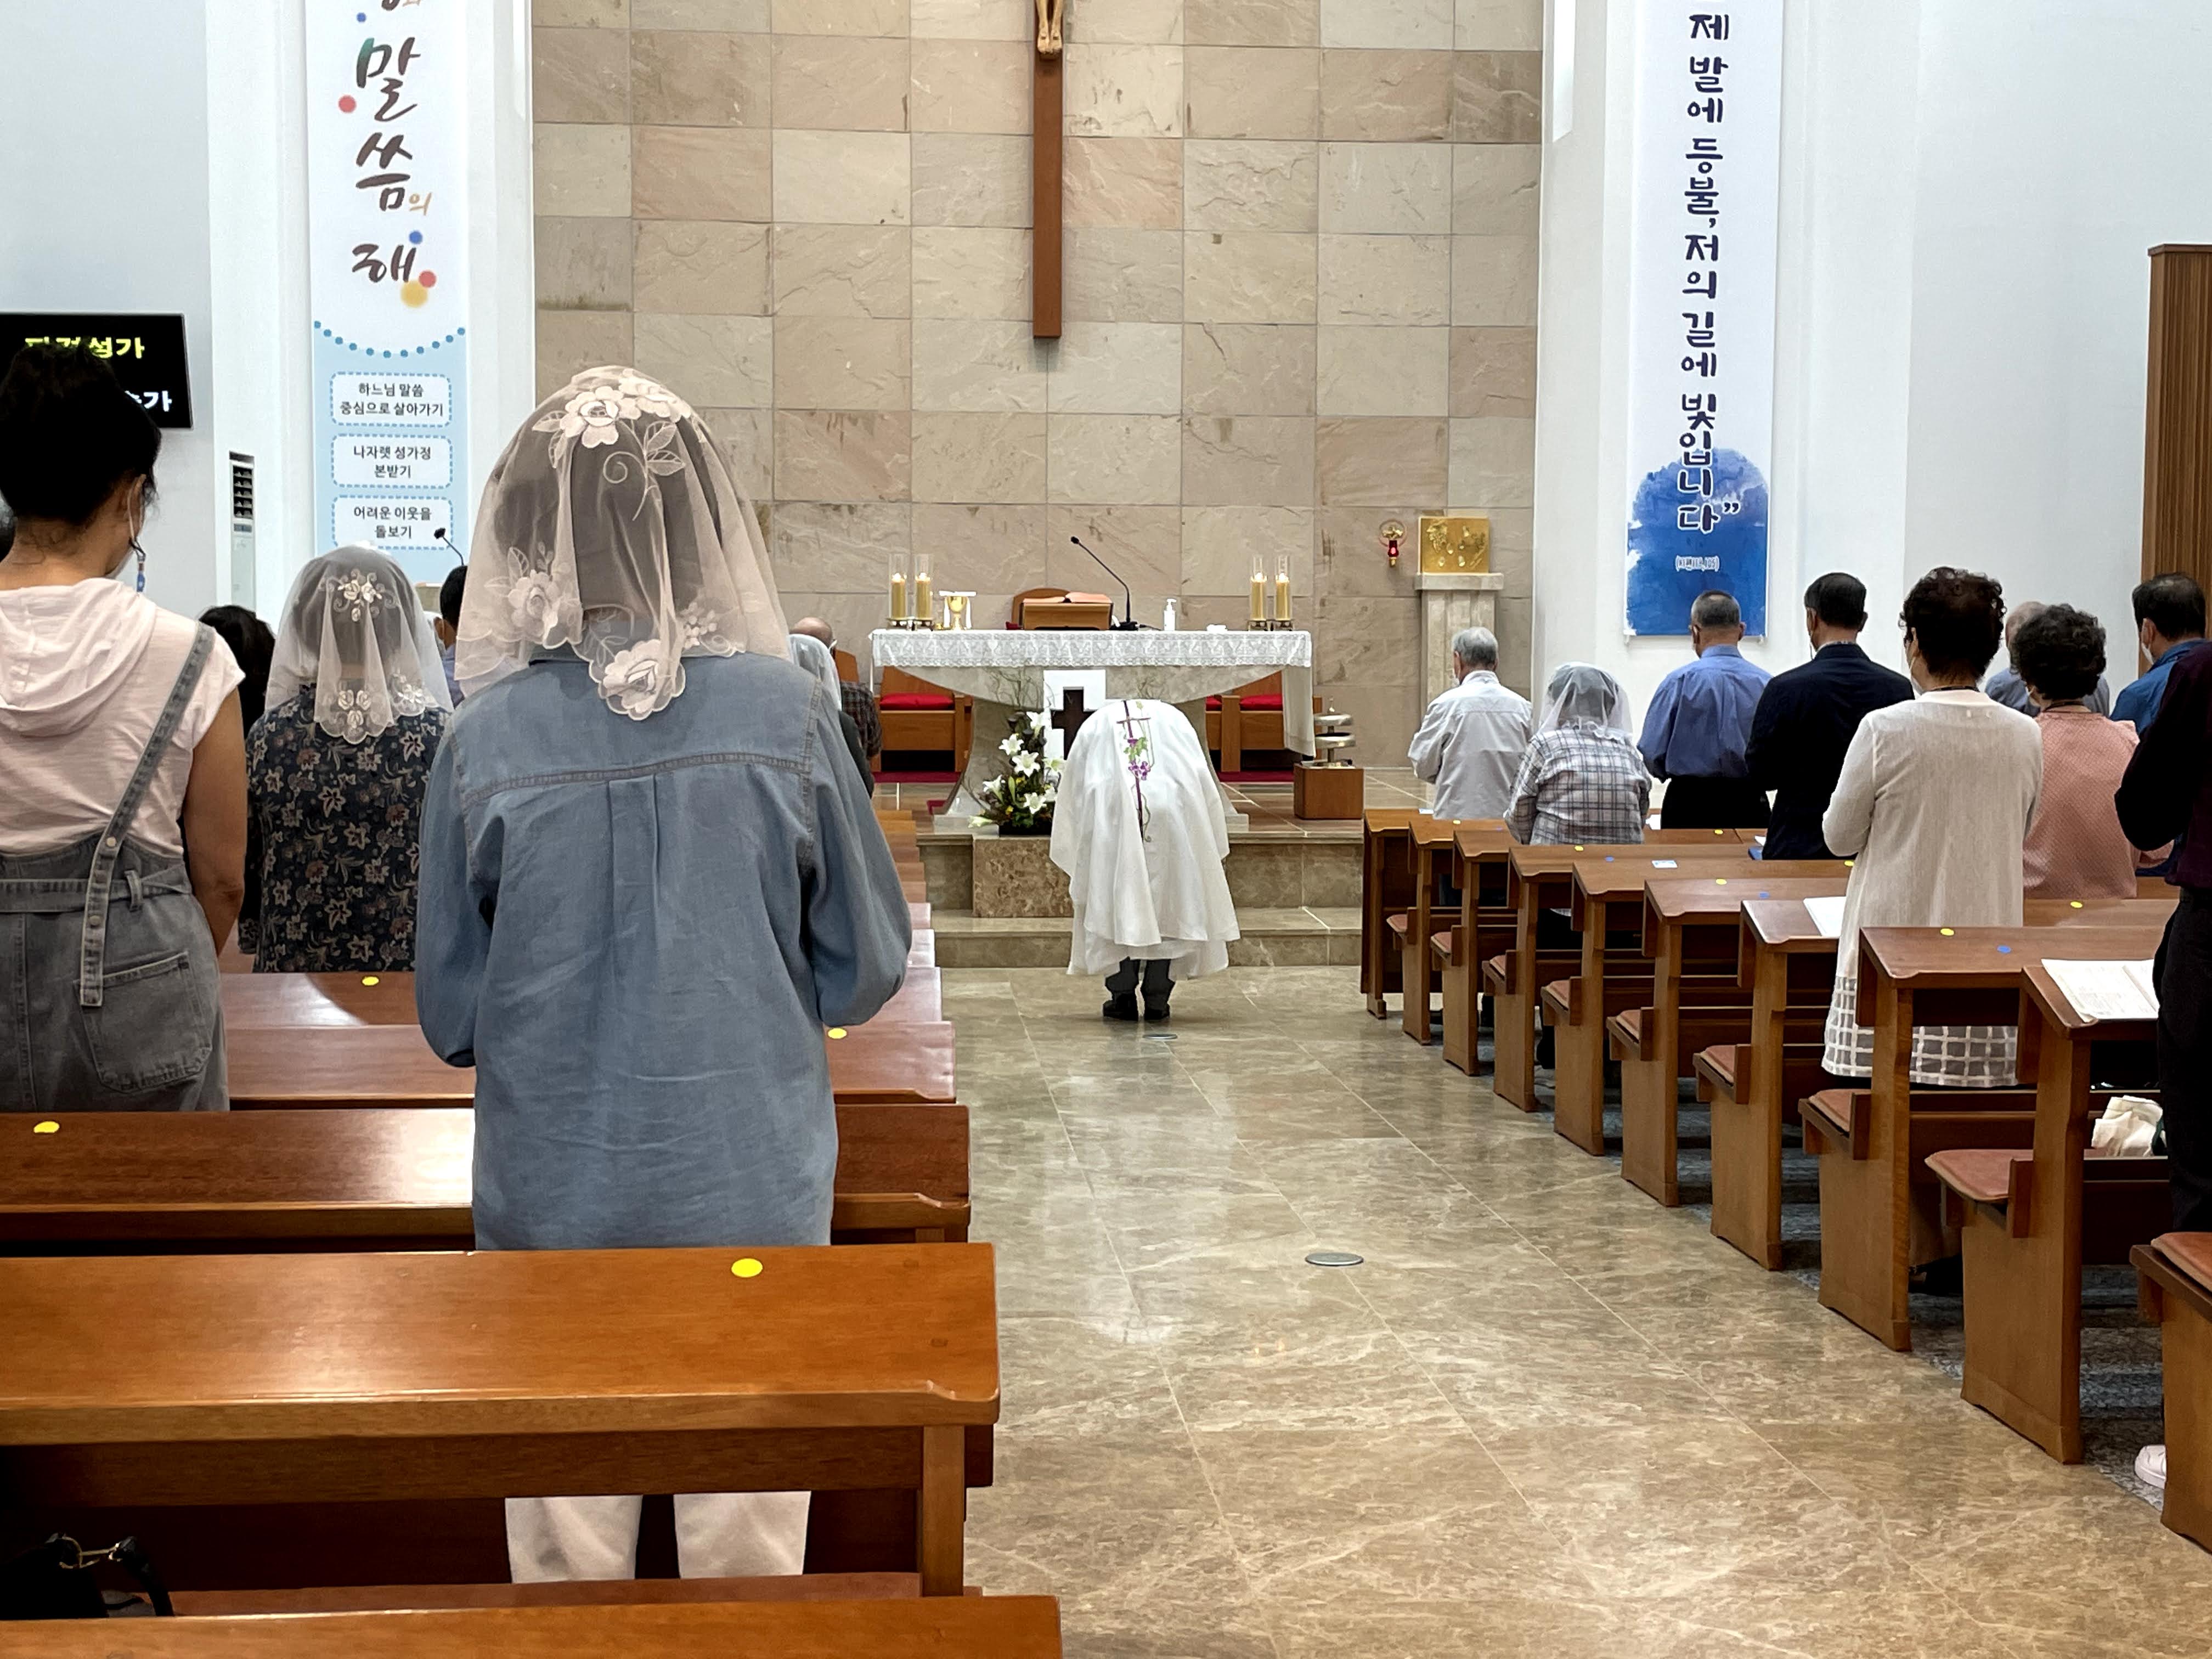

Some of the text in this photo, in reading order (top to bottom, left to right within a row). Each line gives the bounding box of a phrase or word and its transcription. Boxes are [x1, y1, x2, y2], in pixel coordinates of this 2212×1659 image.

[1689, 14, 1729, 40] 제
[1687, 57, 1729, 123] 발에
[352, 243, 417, 283] 해
[1683, 235, 1718, 300] 저의
[1681, 311, 1717, 377] 길에
[358, 382, 424, 398] 하느님 말씀
[340, 401, 443, 416] 중심으로 살아가기
[353, 445, 431, 460] 나자렛 성가정
[374, 464, 411, 479] 본받기
[354, 506, 432, 521] 어려운 이웃을
[374, 524, 412, 540] 돌보기
